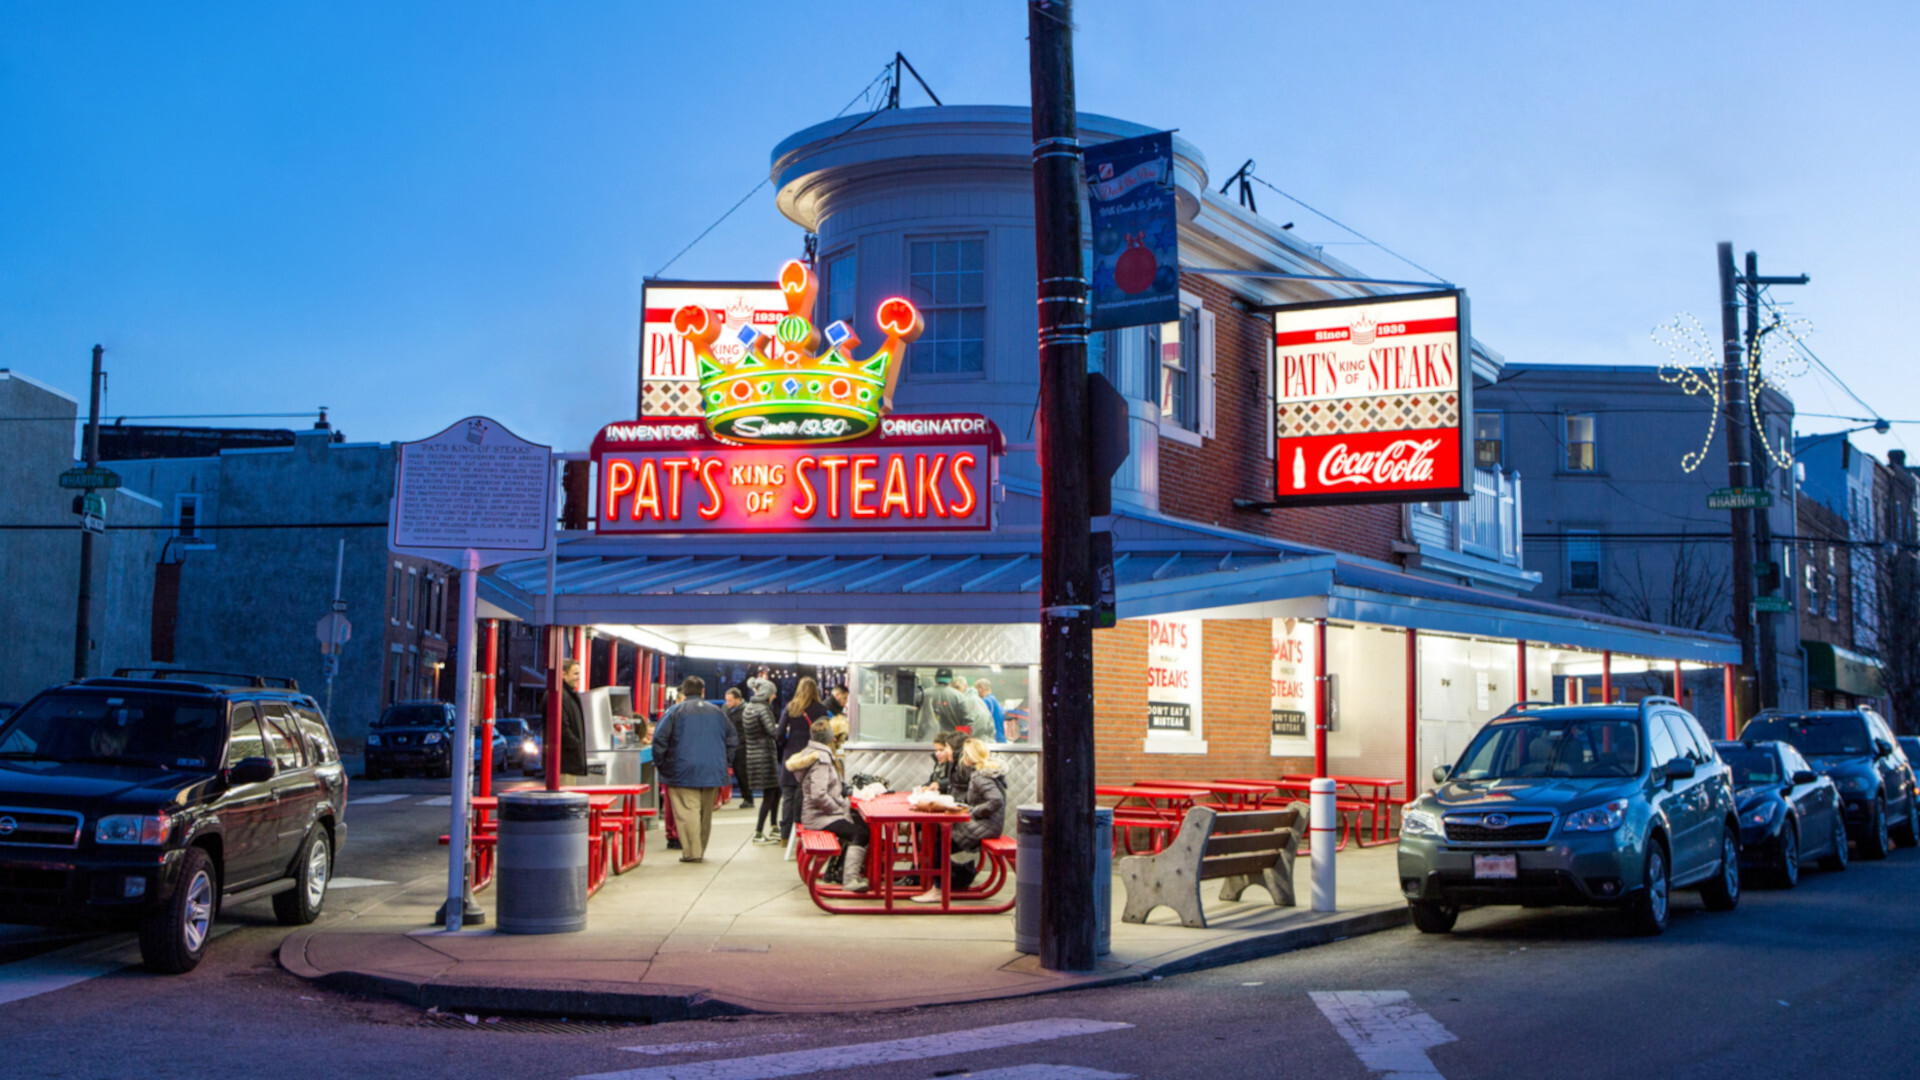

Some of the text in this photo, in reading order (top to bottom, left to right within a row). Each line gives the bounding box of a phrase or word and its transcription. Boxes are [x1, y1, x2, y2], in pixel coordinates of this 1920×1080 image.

[755, 313, 783, 322] 1930
[1315, 324, 1406, 341] Since 1930
[650, 332, 688, 376] PAT
[1283, 342, 1454, 398] PAT'S STEAKS
[1339, 360, 1365, 372] KING
[1345, 374, 1359, 384] OF
[606, 424, 700, 442] INVENTOR
[733, 416, 846, 438] Since 1930
[882, 418, 986, 437] ORIGINATOR
[452, 444, 474, 454] KING
[478, 445, 490, 453] OF
[1318, 438, 1442, 486] Coca-Cola
[730, 464, 786, 486] KING
[605, 450, 978, 521] PAT'S STEAKS
[746, 490, 774, 513] OF
[1709, 494, 1768, 508] WHARTON ST
[1150, 619, 1188, 649] PAT'S
[1272, 638, 1302, 664] PAT'S
[1148, 666, 1188, 689] STEAKS
[1271, 679, 1304, 698] STEAKS
[1170, 706, 1183, 716] EAT
[1185, 707, 1190, 716] A
[1288, 714, 1300, 723] EAT
